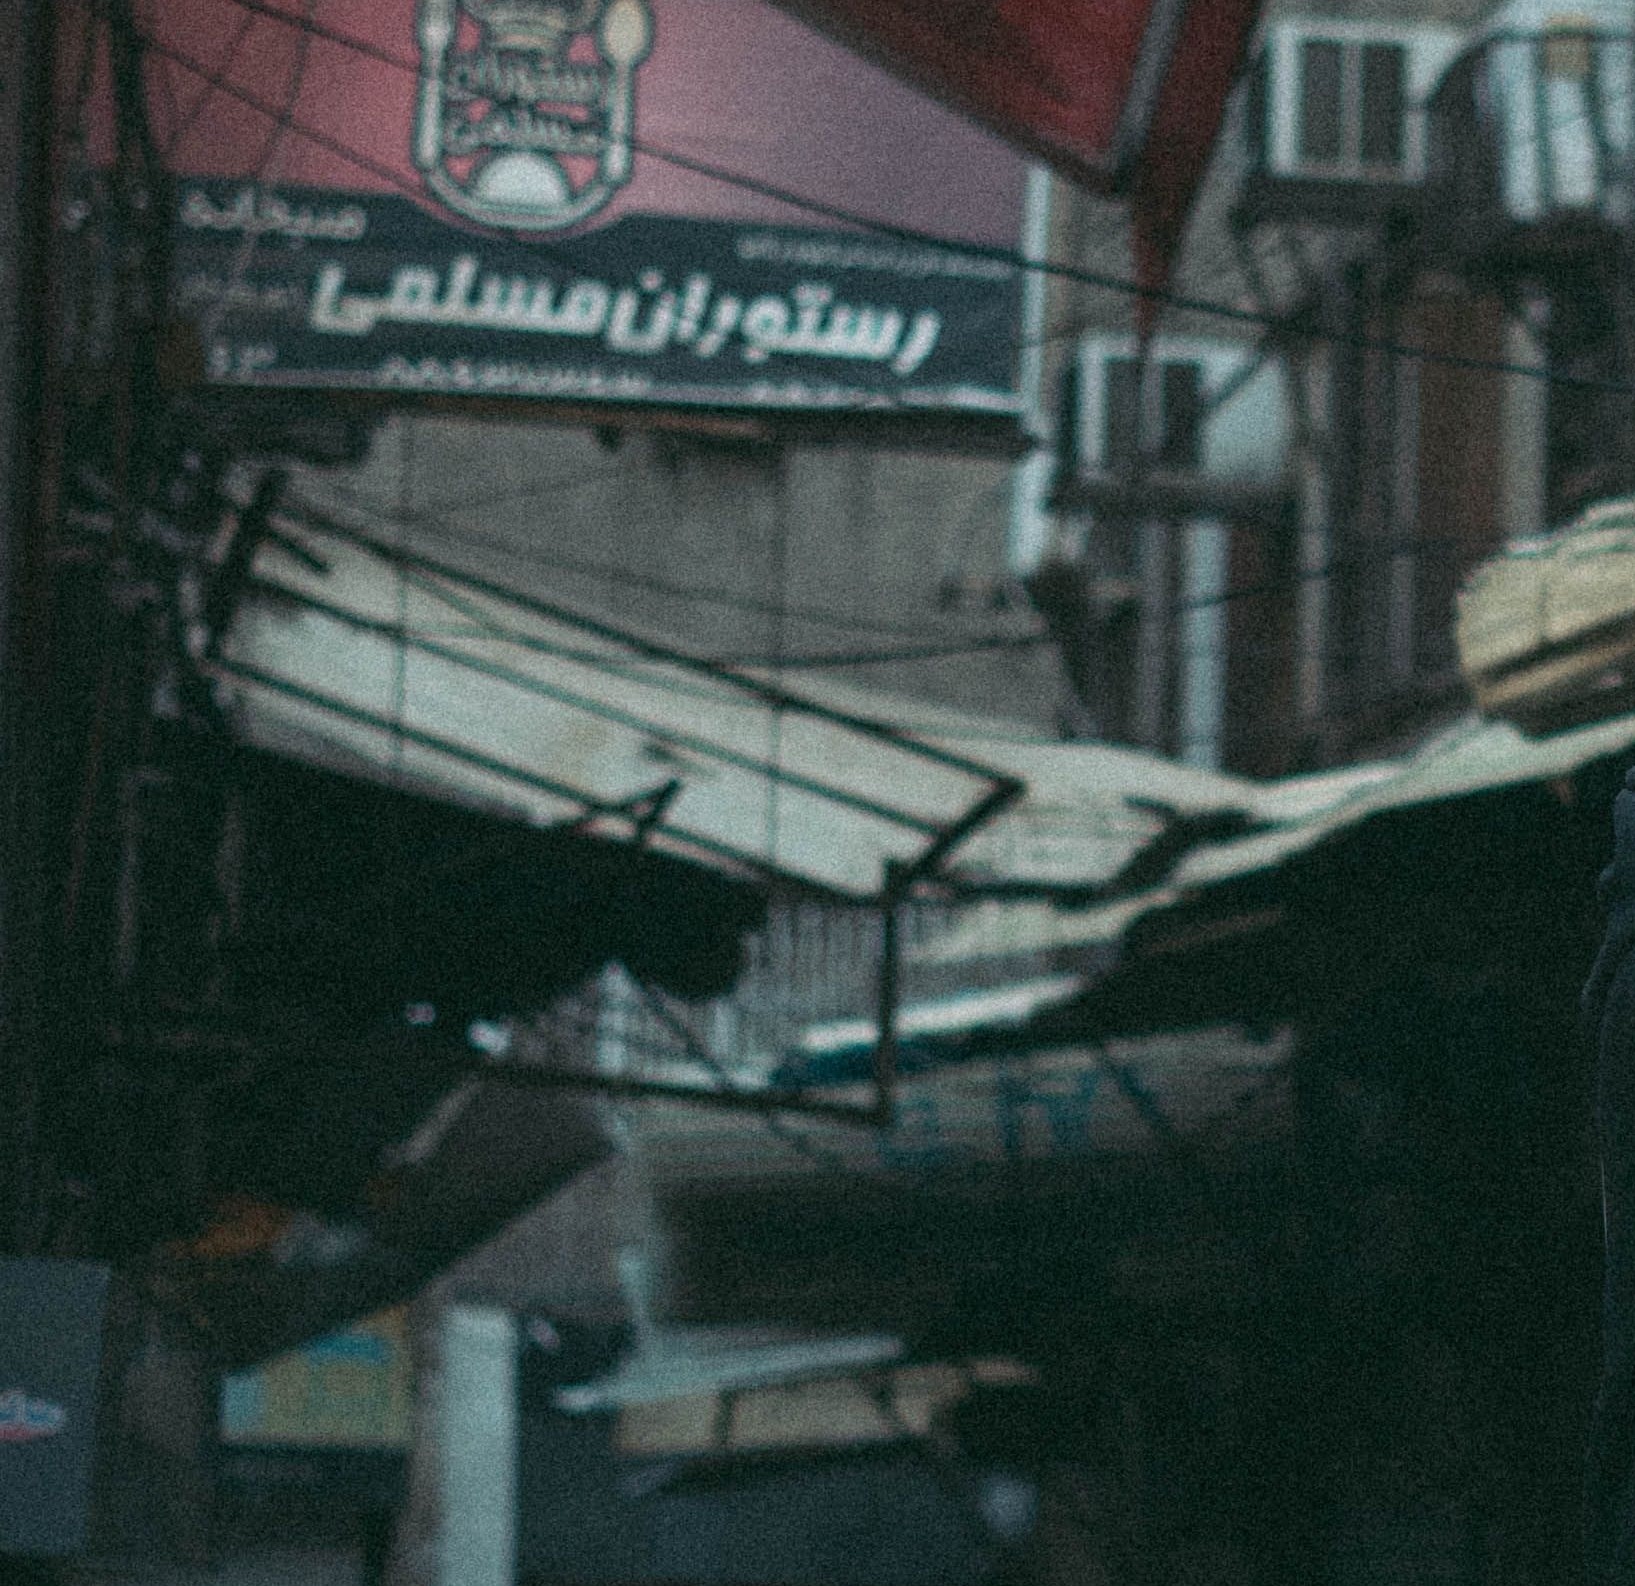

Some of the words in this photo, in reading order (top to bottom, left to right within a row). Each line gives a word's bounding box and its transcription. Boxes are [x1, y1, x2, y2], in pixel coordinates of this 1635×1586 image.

[445, 54, 609, 107] رستوران
[309, 253, 611, 335] مسلمی
[607, 267, 940, 376] رستوران
